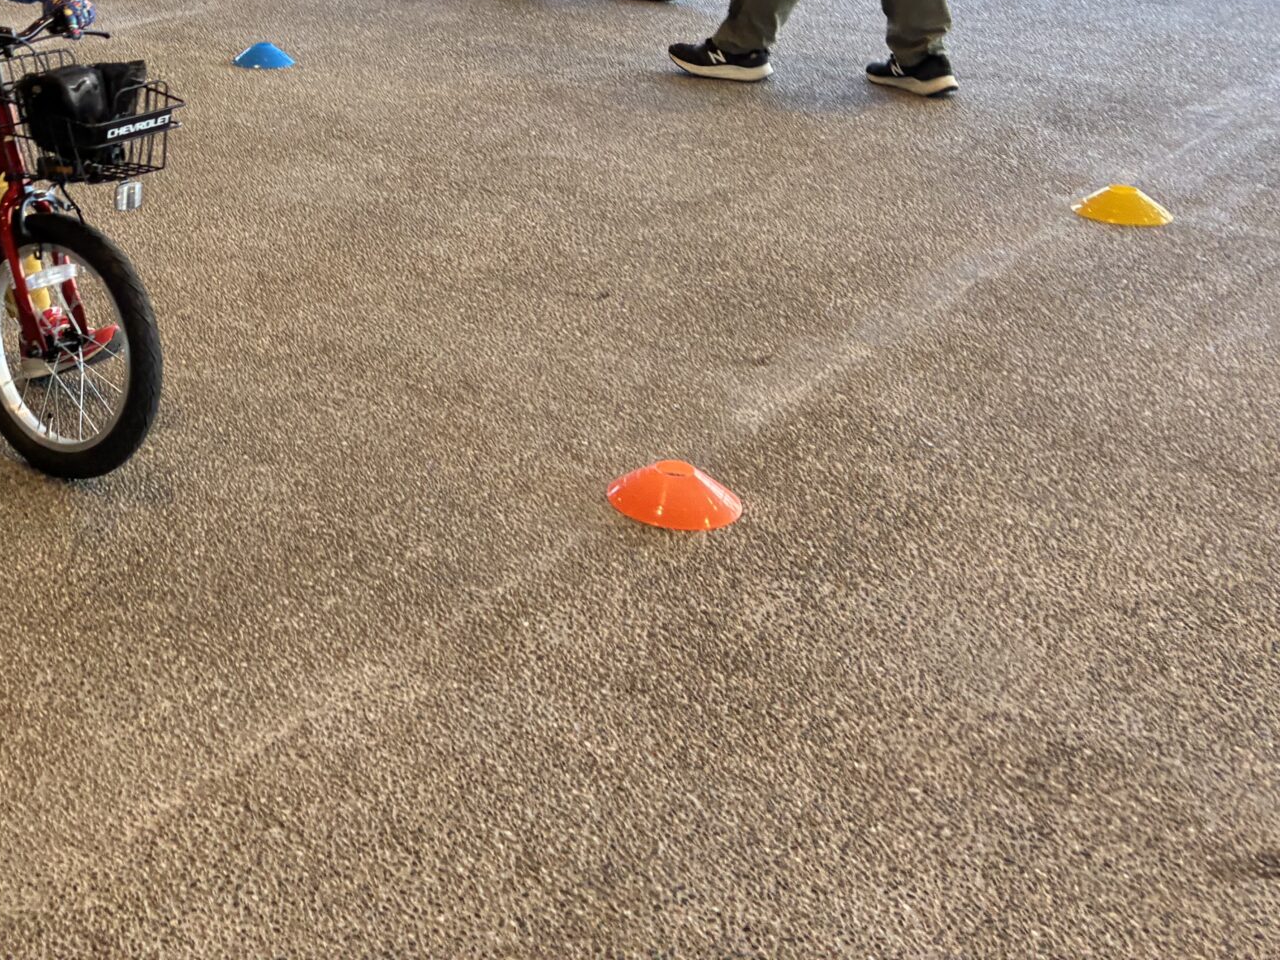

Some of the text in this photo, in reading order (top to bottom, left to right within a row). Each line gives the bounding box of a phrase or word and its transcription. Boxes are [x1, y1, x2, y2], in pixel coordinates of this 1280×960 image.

[708, 49, 727, 64] N
[890, 62, 904, 76] N
[106, 114, 172, 139] CHEVROLET
